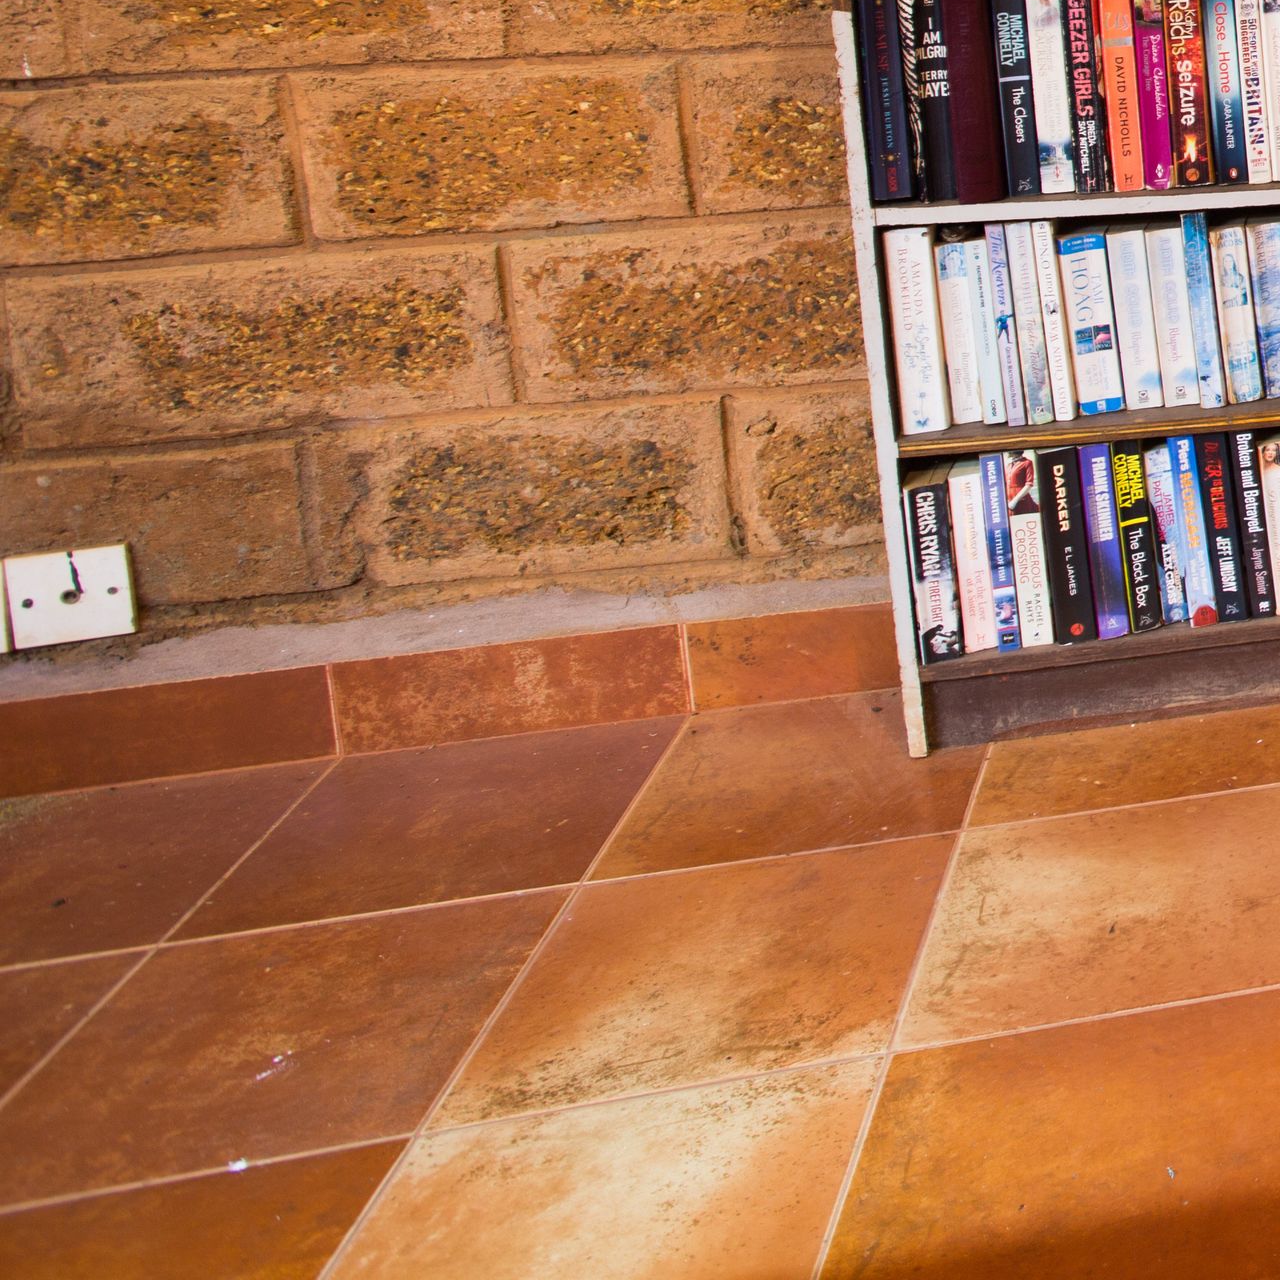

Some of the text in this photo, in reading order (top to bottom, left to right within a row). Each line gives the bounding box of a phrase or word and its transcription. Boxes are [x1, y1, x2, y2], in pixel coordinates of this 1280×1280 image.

[996, 12, 1013, 67] CONNELLY
[1009, 14, 1025, 62] MICHAEL
[1213, 2, 1228, 41] Close
[1115, 56, 1131, 158] DAVID NICHOLLS
[1071, 257, 1093, 322] HOAG
[1052, 464, 1069, 533] DARKER
[1129, 528, 1149, 609] The Black Box
